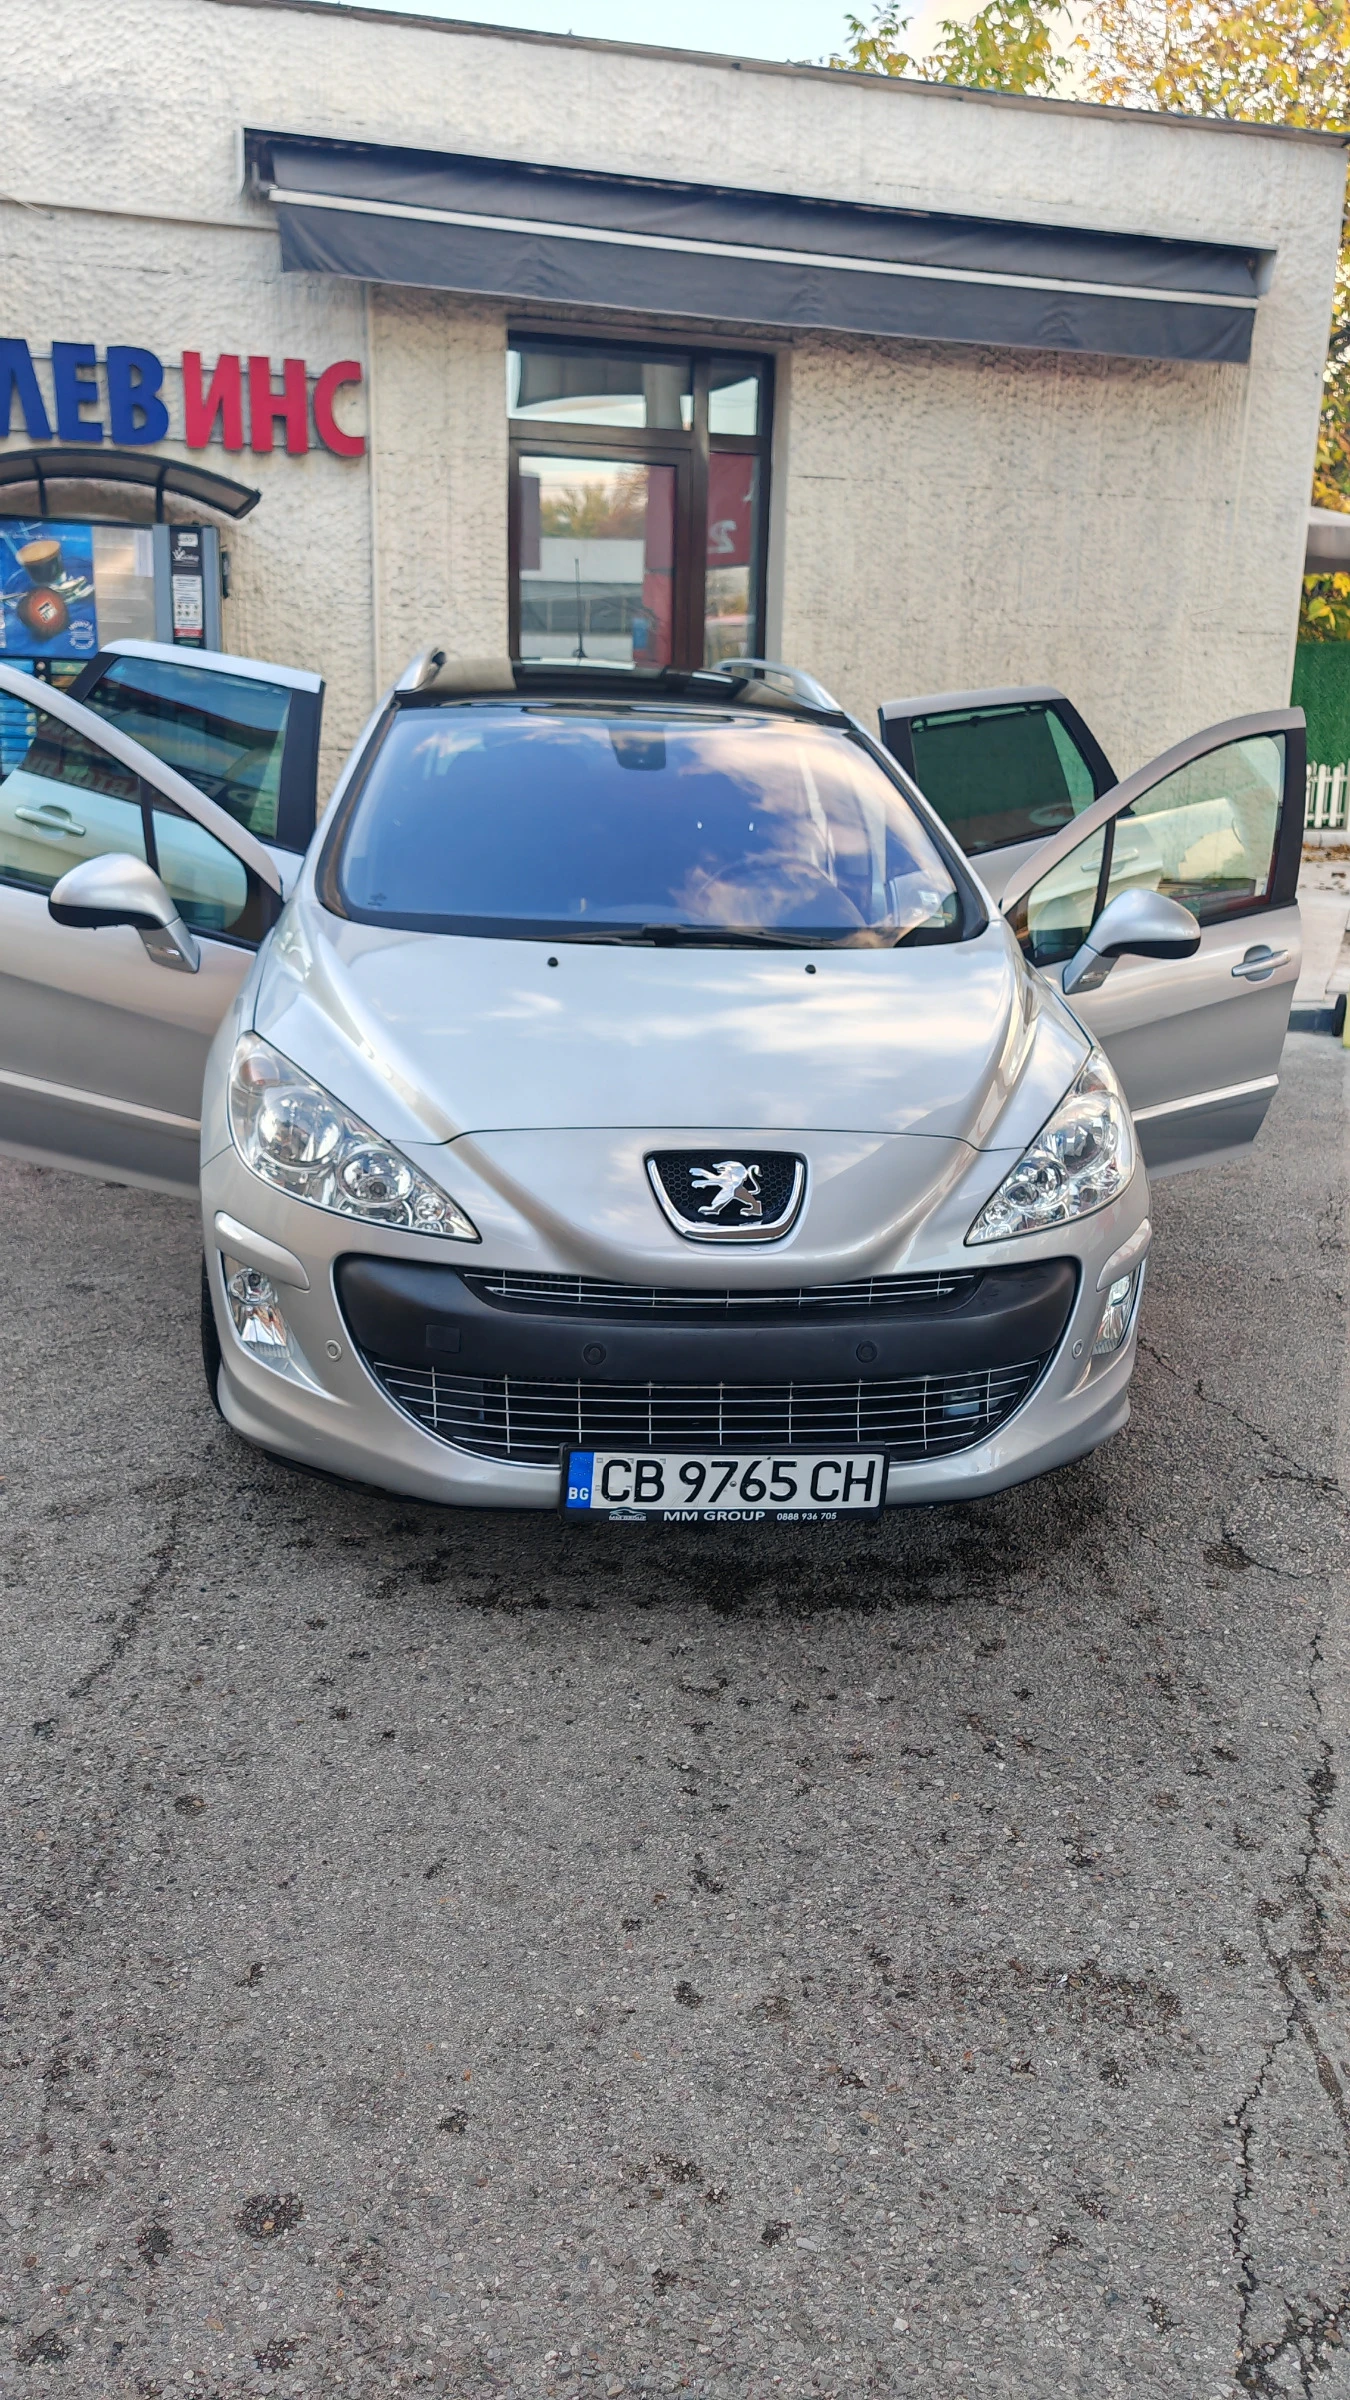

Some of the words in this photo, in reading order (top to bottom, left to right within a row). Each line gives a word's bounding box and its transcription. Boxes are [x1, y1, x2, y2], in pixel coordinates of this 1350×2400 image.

[182, 350, 365, 457] ИНС
[568, 1486, 589, 1500] BG
[601, 1459, 665, 1503] CB
[679, 1460, 797, 1503] 9765
[810, 1460, 876, 1502] CH
[663, 1511, 698, 1521] MM
[703, 1510, 766, 1521] GROUP
[777, 1512, 799, 1521] 0888
[801, 1512, 818, 1521] 936
[820, 1512, 837, 1520] 705
